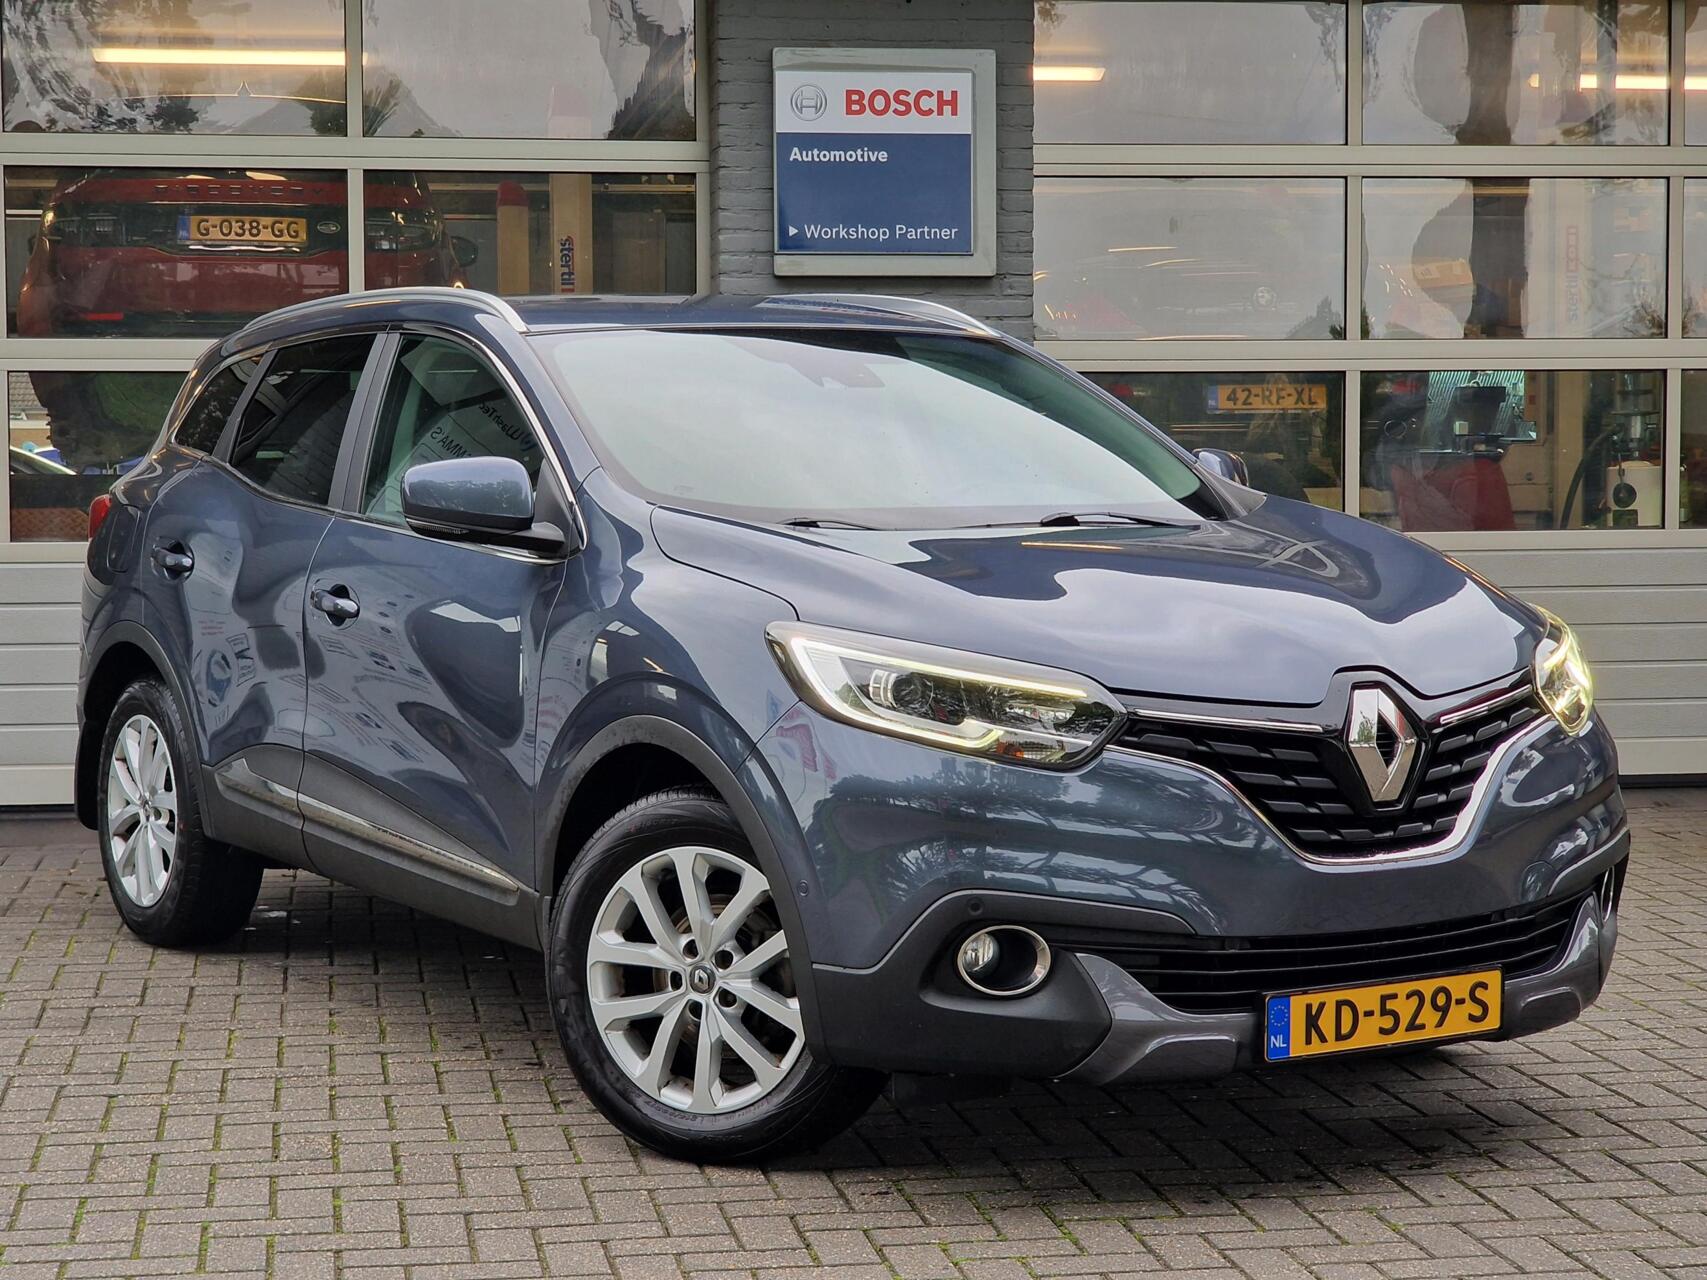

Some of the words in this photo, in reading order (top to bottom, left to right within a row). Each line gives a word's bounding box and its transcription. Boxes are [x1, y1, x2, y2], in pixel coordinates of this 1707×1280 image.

[845, 89, 959, 117] BOSCH
[789, 147, 889, 162] Automotive
[197, 218, 300, 239] G-038-GG
[804, 224, 890, 242] Workshop
[895, 225, 959, 240] Partner
[560, 236, 575, 286] stertil
[1270, 1034, 1287, 1049] NL
[1305, 981, 1489, 1046] KD-529-S
